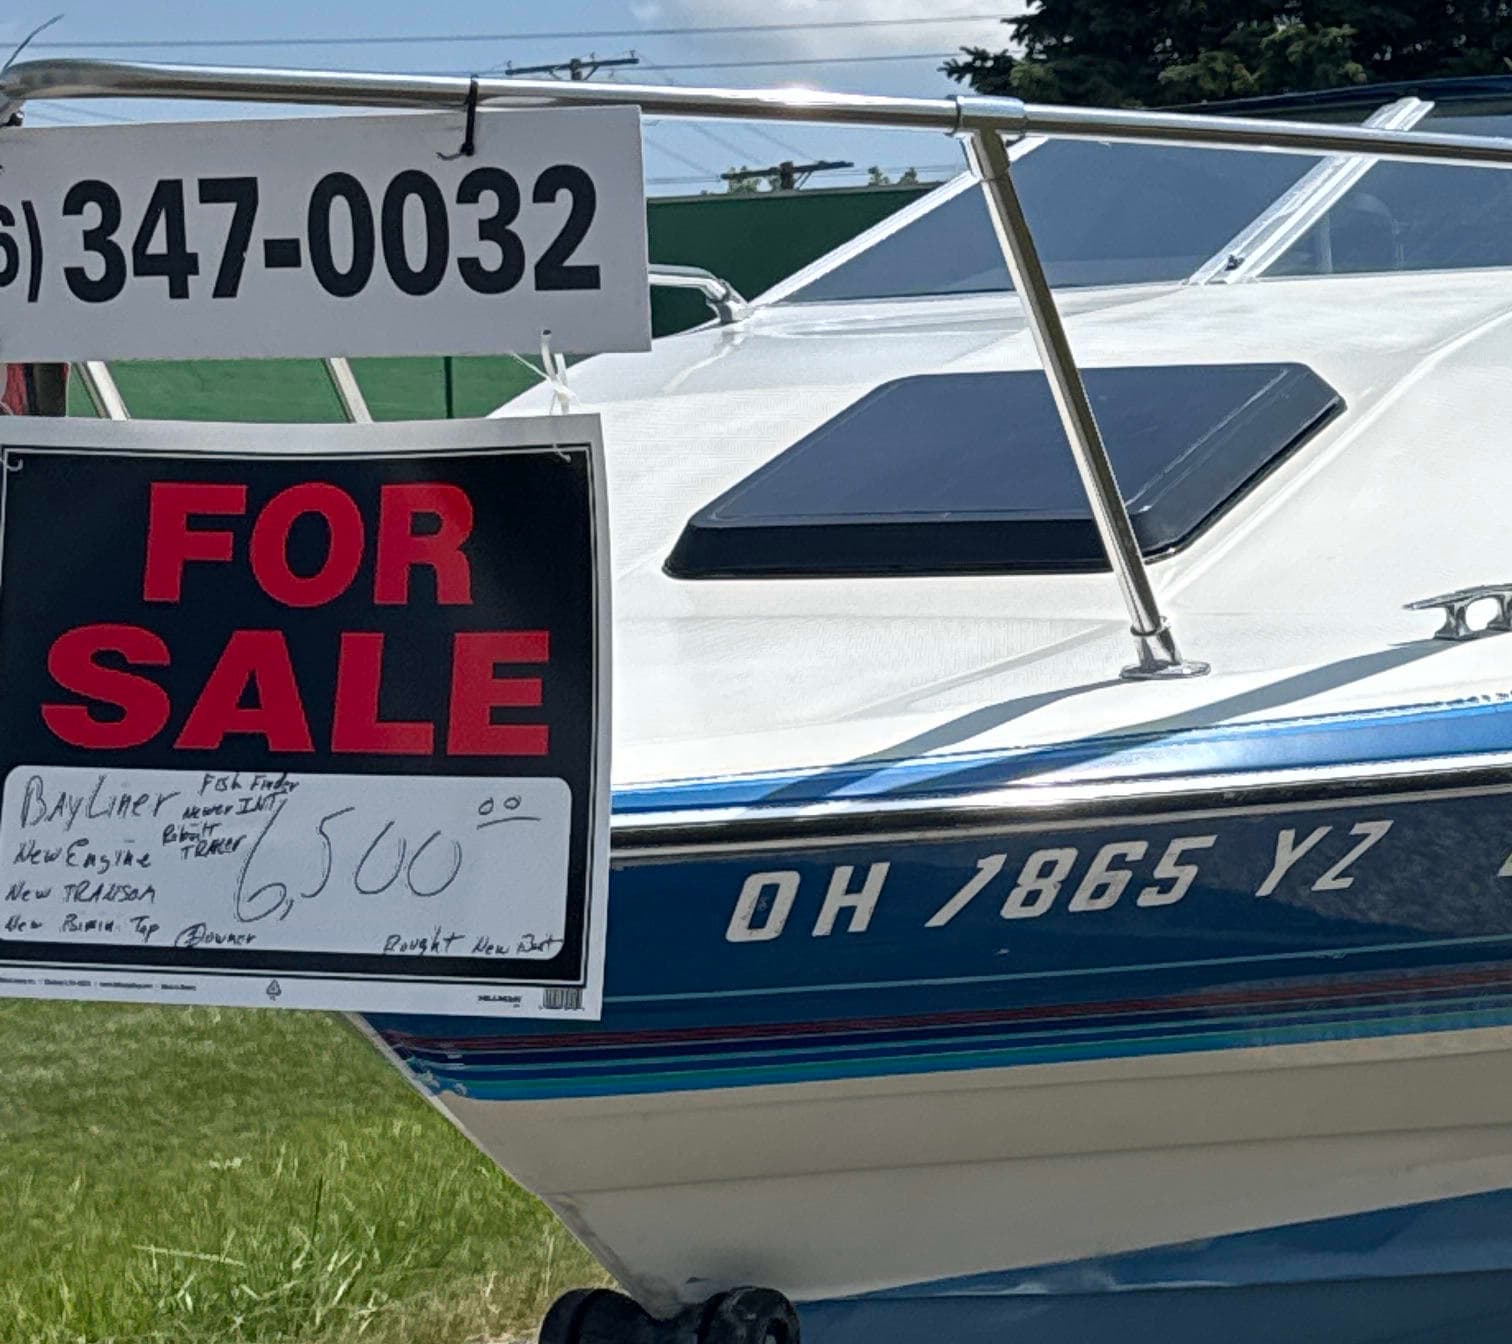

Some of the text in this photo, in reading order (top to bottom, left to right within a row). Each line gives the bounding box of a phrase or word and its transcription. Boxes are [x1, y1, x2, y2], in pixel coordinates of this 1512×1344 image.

[62, 164, 601, 303] 347-0032
[143, 481, 474, 609] FOR
[40, 622, 551, 757] SALE
[5, 880, 51, 902] New
[14, 837, 152, 875] New Engine
[234, 798, 462, 923] 6,500
[725, 861, 891, 943] OH
[923, 835, 1217, 928] 1865
[5, 914, 43, 932] New
